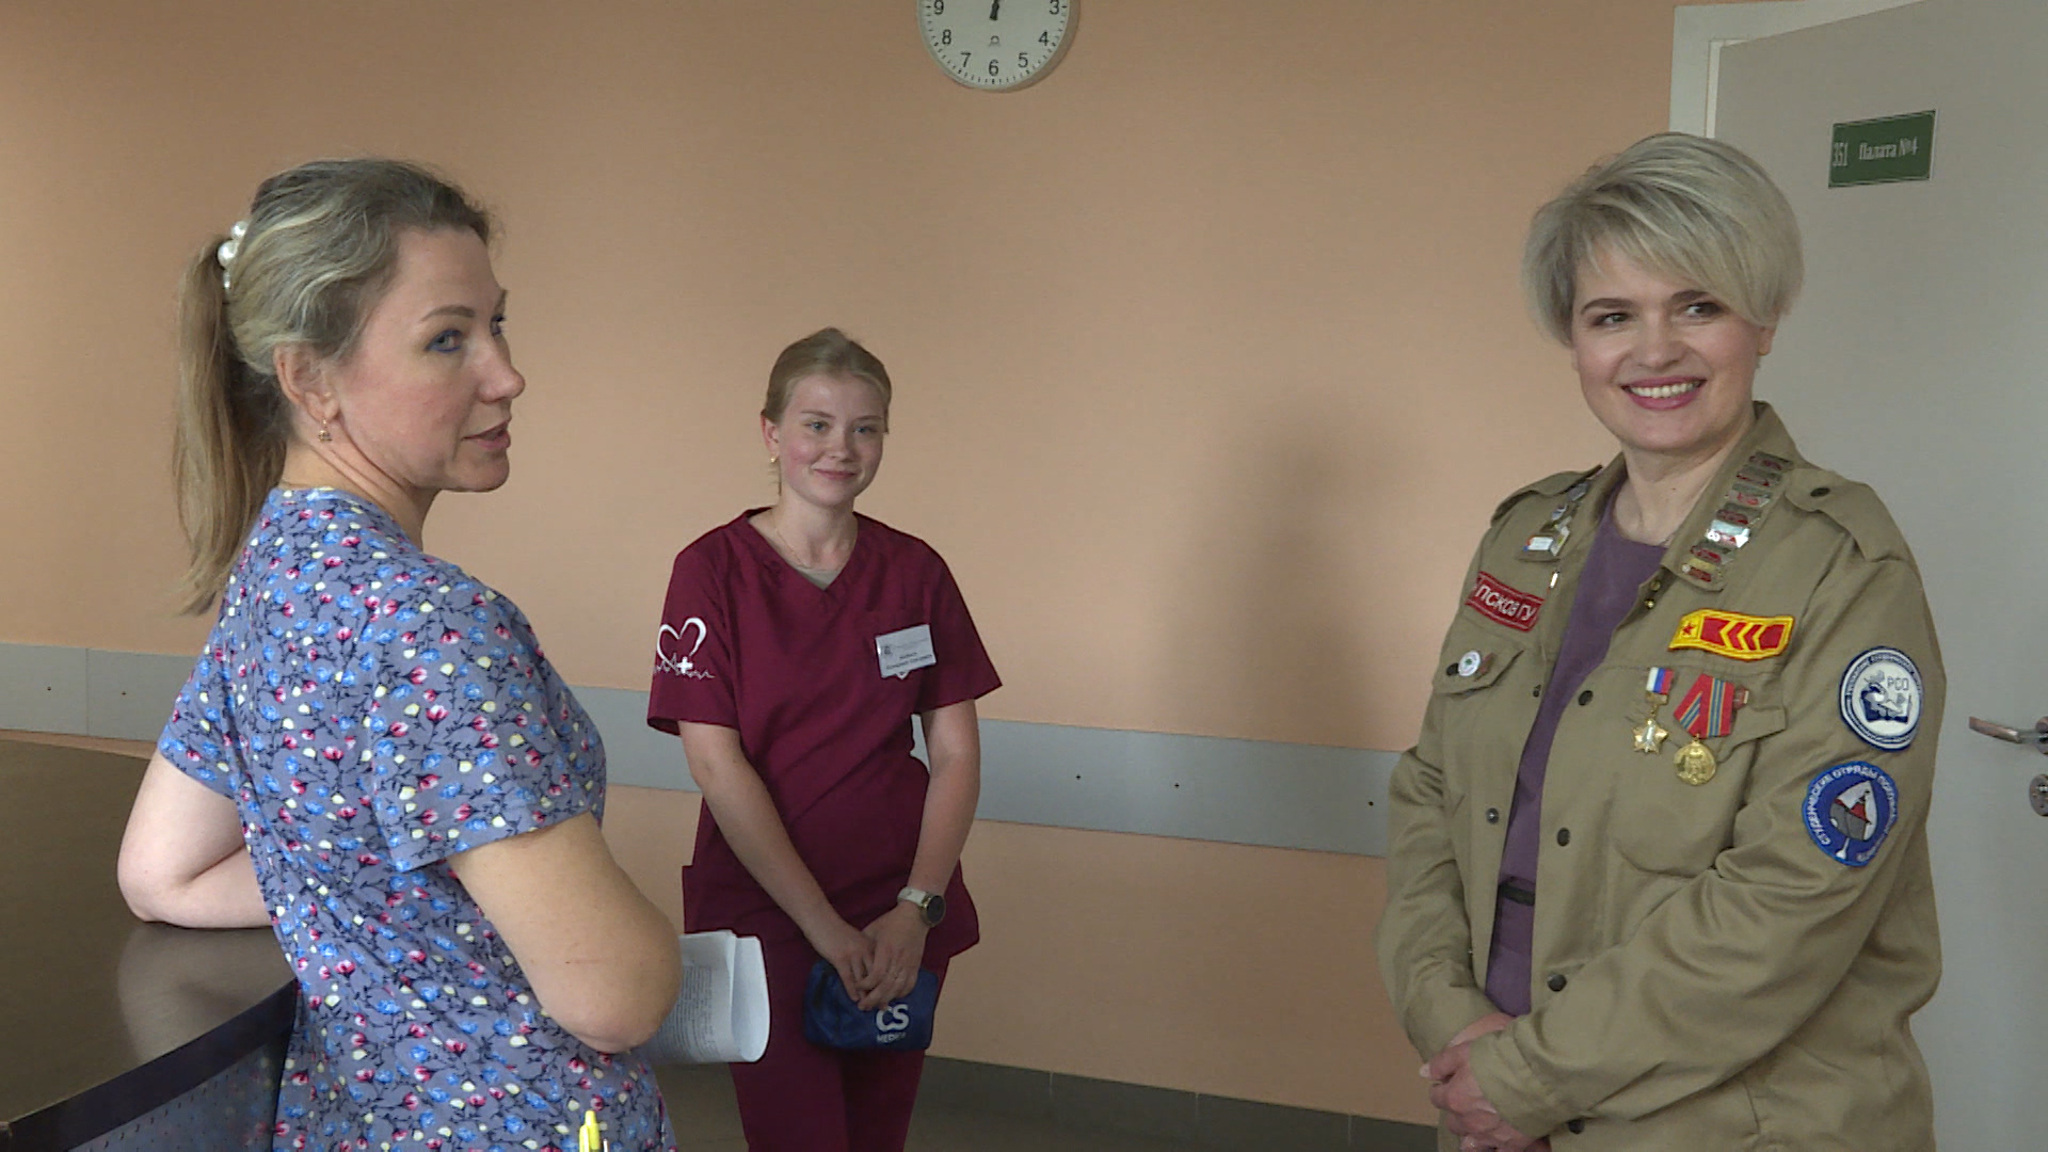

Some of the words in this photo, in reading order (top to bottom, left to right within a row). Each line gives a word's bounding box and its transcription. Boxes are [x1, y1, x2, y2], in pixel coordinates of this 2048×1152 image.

[934, 0, 944, 15] 9
[1049, 0, 1060, 15] 3
[942, 29, 952, 45] 8
[1038, 31, 1049, 46] 4
[960, 52, 971, 68] 7
[988, 59, 999, 76] 6
[1018, 52, 1029, 68] 5
[876, 1003, 910, 1032] CS
